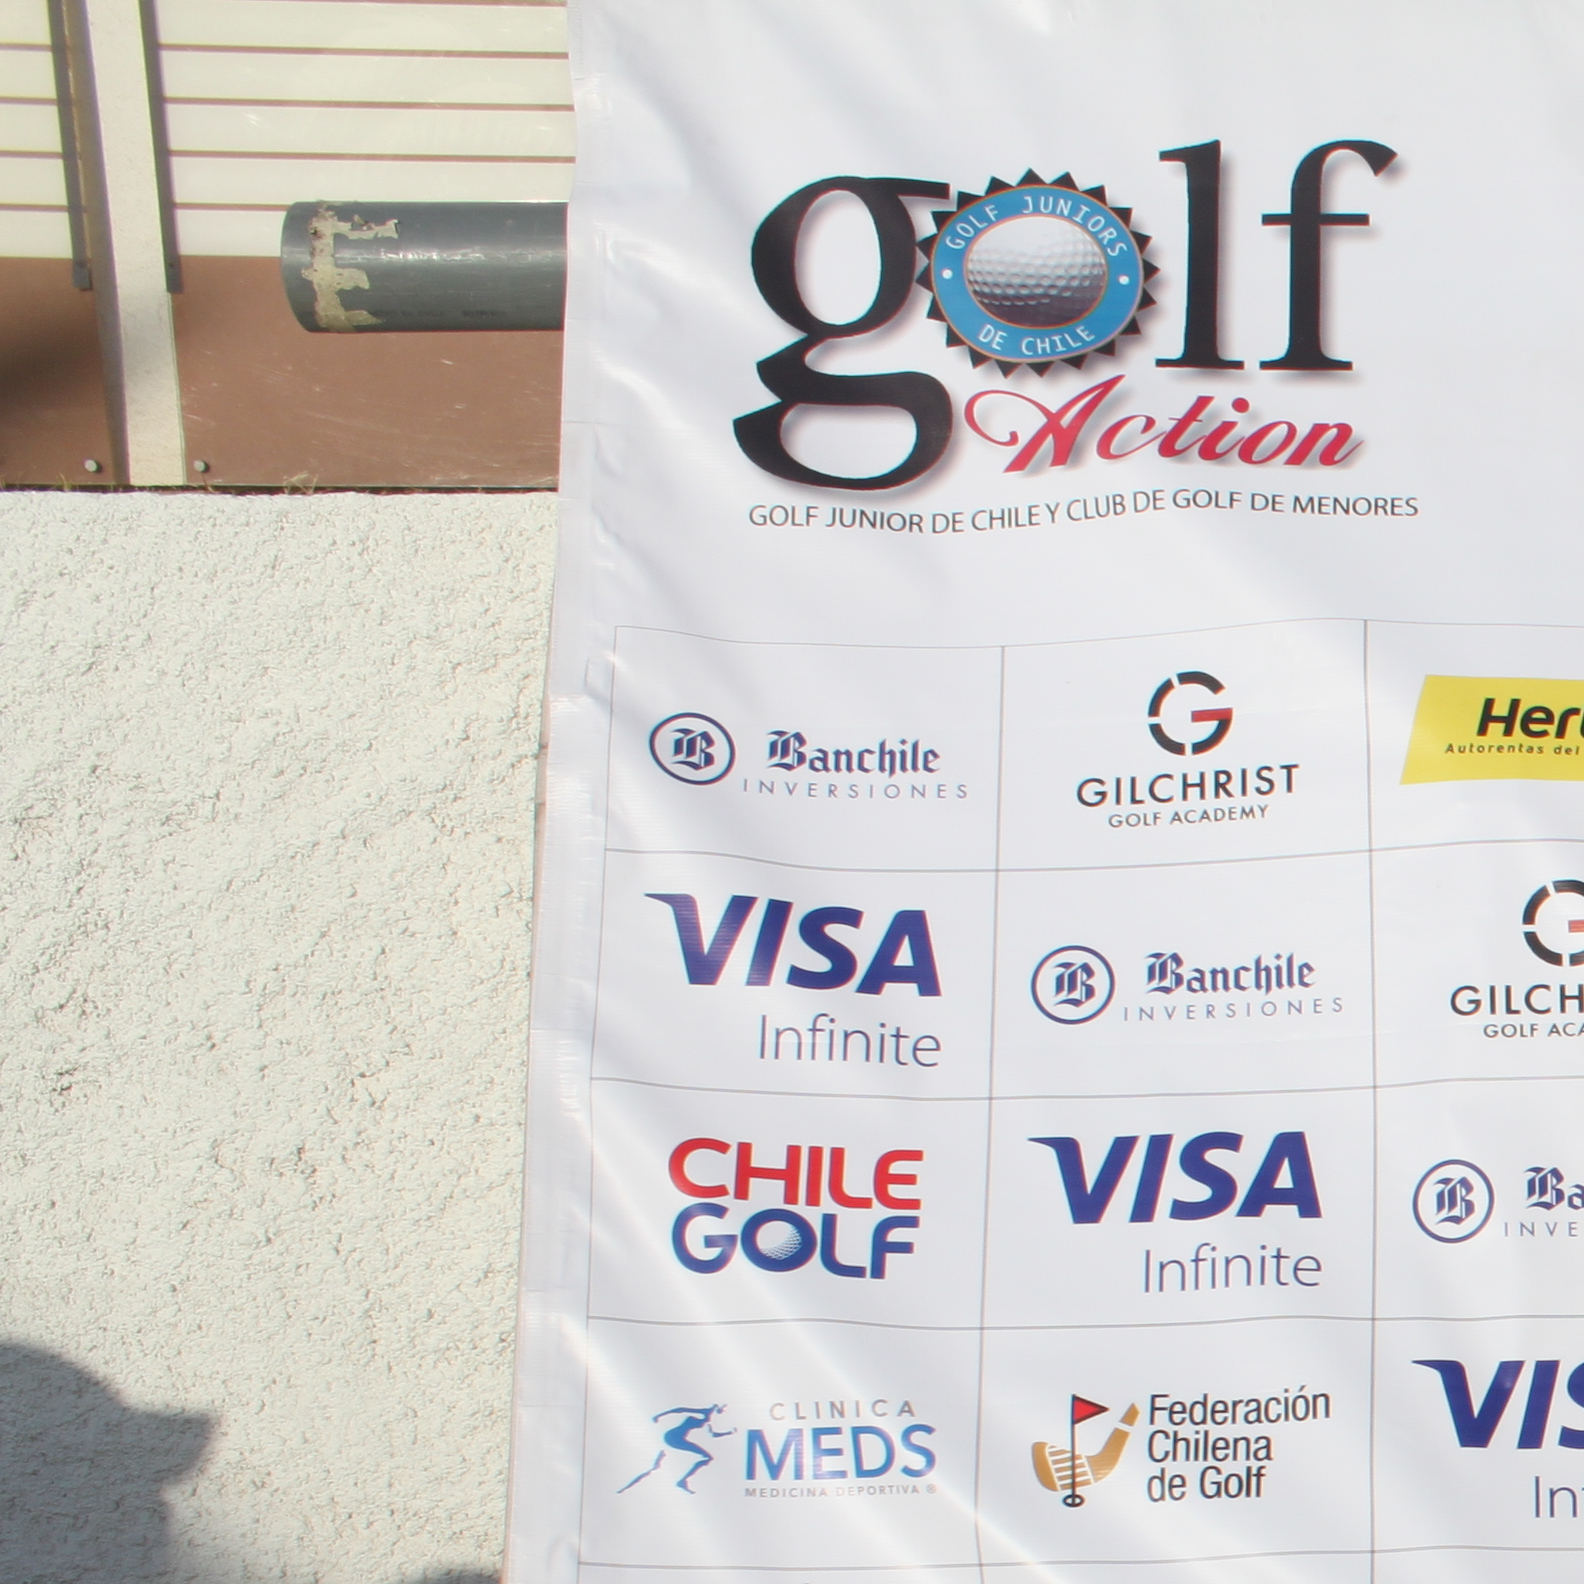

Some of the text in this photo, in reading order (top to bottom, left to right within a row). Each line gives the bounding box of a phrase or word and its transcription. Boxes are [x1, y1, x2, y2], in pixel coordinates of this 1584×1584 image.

[945, 195, 1128, 257] GOLF JUNIORS
[732, 139, 1399, 491] golf
[977, 323, 1096, 356] DE CHILE
[963, 374, 1365, 473] Action
[748, 488, 1420, 534] GOLF JUNIOR DE CHILE Y CLUB DE GOLF DE MENORES
[765, 729, 941, 778] Banchile
[1444, 741, 1545, 757] Autorentas
[1551, 743, 1582, 758] del
[742, 778, 970, 800] INVERSIONES
[1075, 763, 1300, 808] GILCHRIST
[1107, 803, 1269, 829] GOLF ACADEMY
[644, 892, 943, 997] VISA
[1144, 950, 1317, 997] Banchile
[1122, 997, 1344, 1022] INVERSIONES
[1483, 1021, 1540, 1039] GOLF
[759, 1013, 943, 1068] Infinite
[668, 1137, 924, 1211] CHILE
[1027, 1130, 1323, 1225] VISA
[671, 1201, 921, 1279] GOLF
[1143, 1243, 1323, 1293] Infinite
[769, 1398, 917, 1421] CLINICA
[1148, 1384, 1332, 1427] Federación
[744, 1423, 938, 1482] MEDS
[1146, 1429, 1273, 1464] Chilena
[744, 1483, 923, 1499] MEDICINA DEPORTIVA
[1146, 1463, 1267, 1503] de Golf
